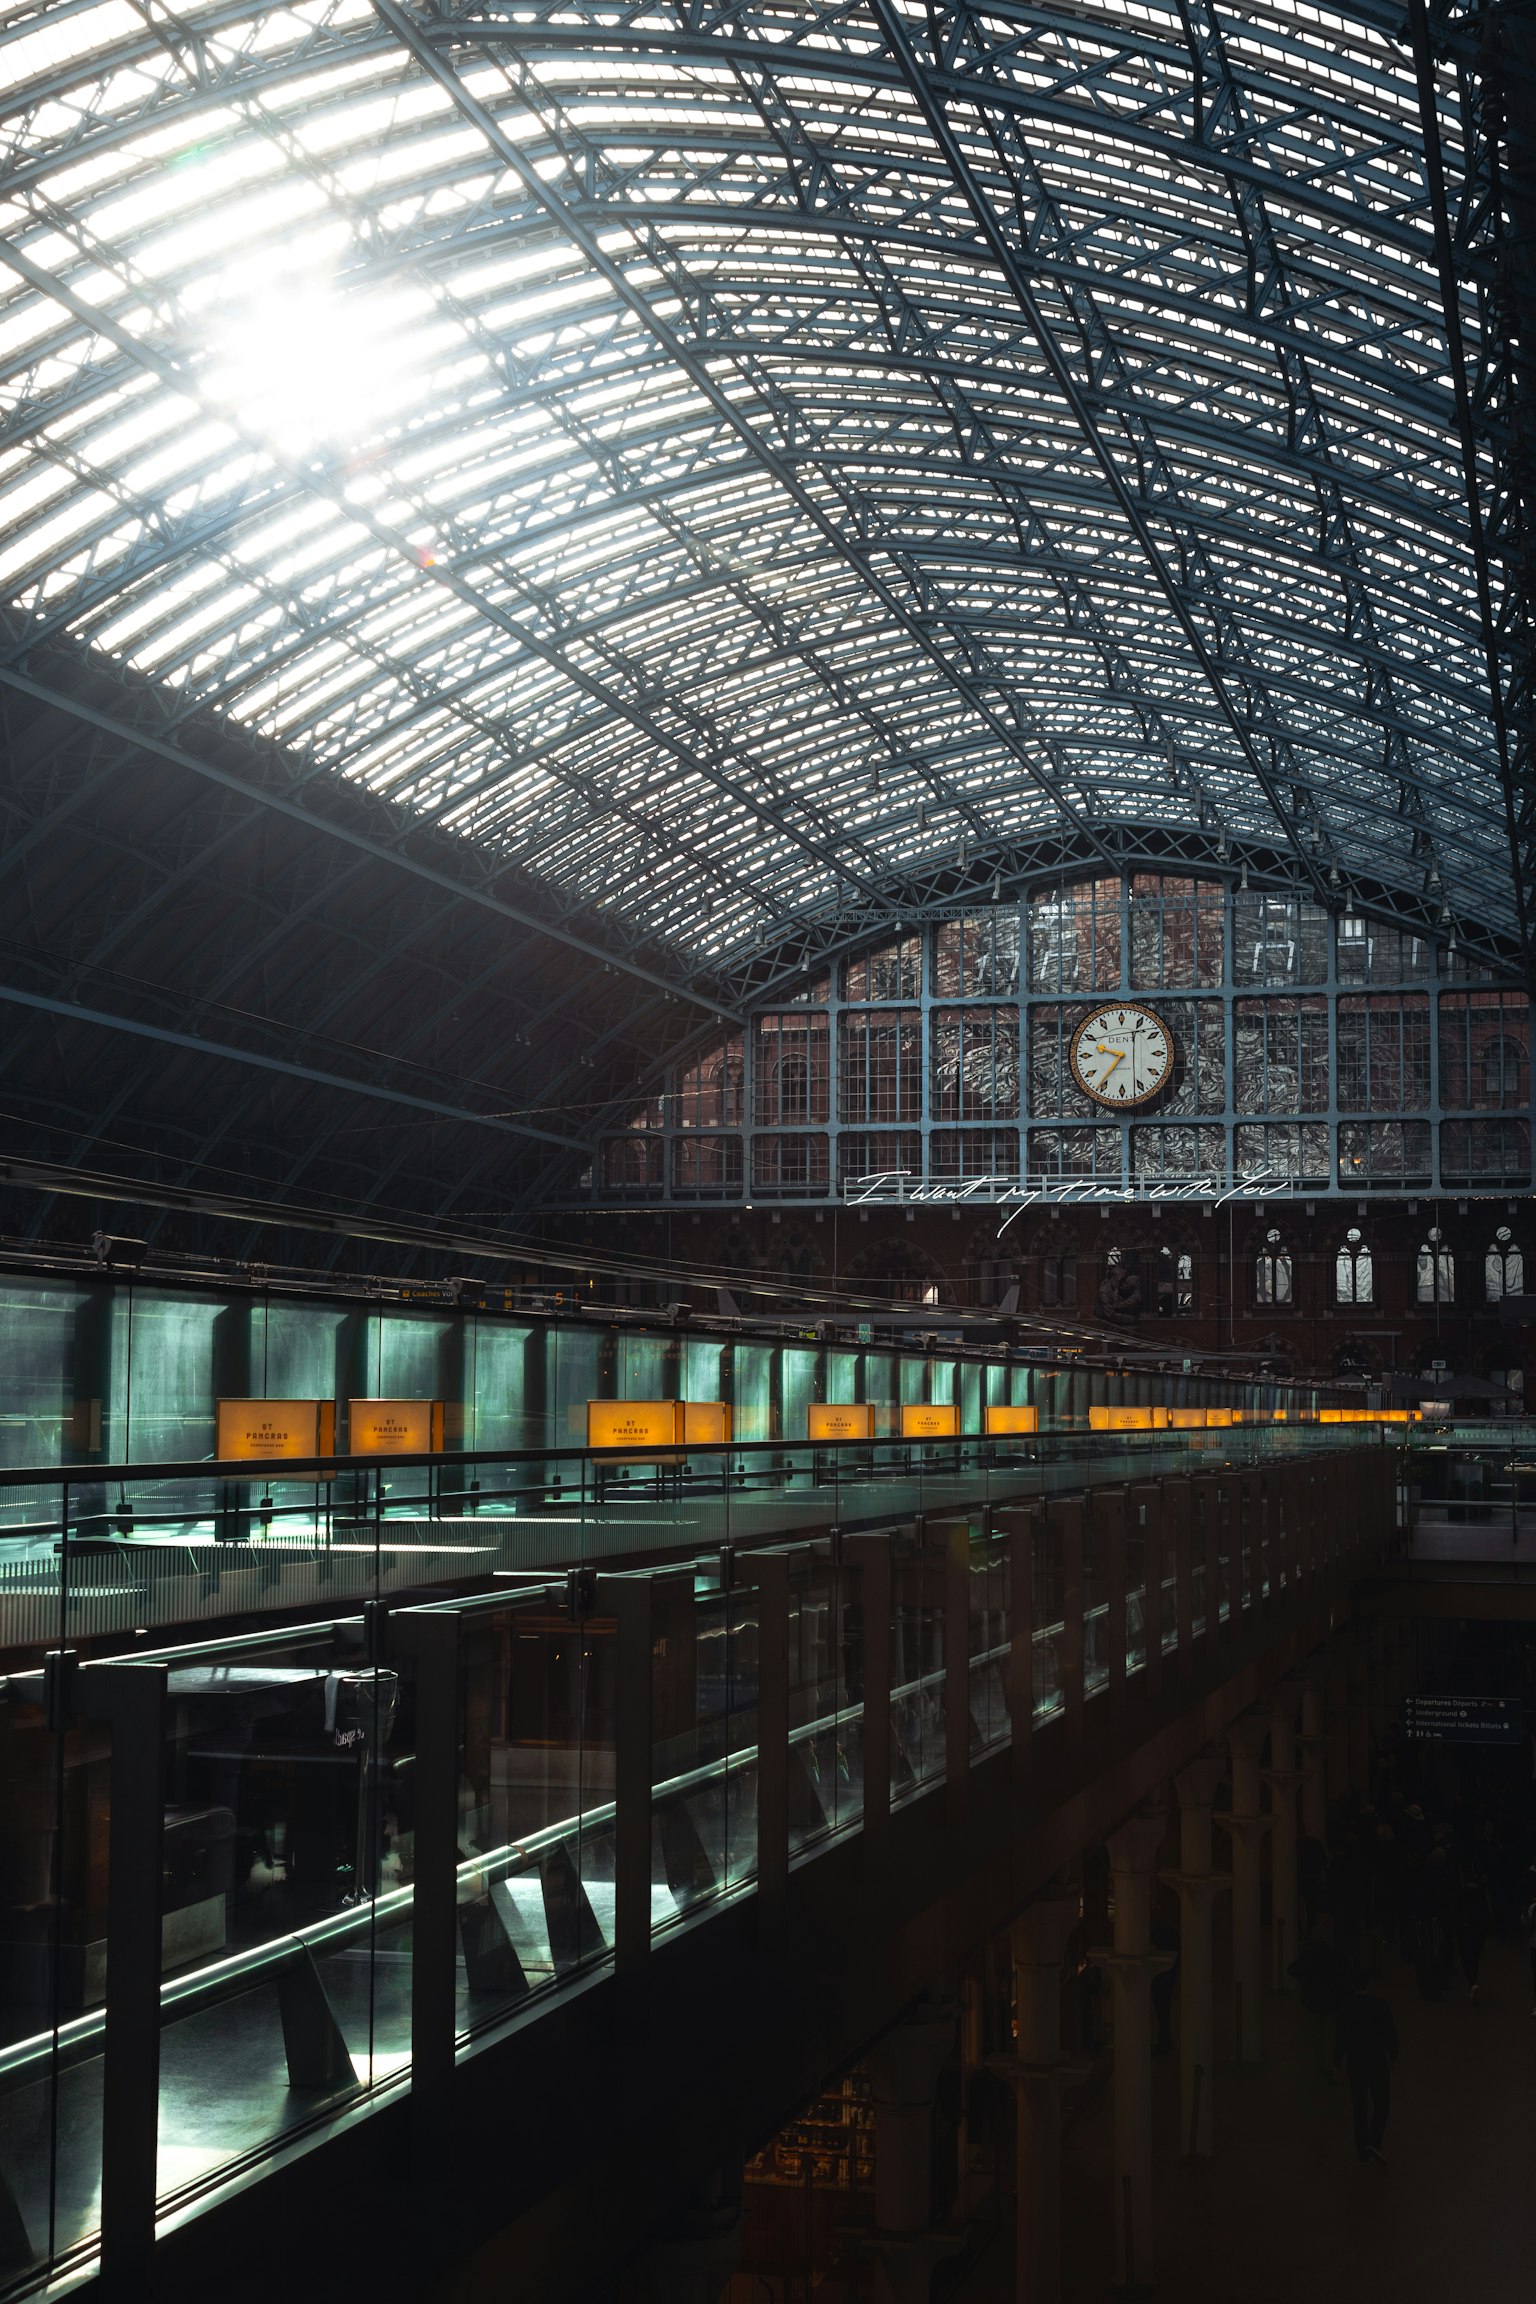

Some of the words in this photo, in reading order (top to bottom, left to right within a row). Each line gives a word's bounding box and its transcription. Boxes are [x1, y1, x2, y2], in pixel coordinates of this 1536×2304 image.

[846, 1170, 912, 1207] I
[554, 1292, 565, 1306] 5
[246, 1432, 288, 1440] PANCRAS
[1415, 1698, 1452, 1707] Departures
[1415, 1709, 1458, 1718] Underground
[1415, 1720, 1457, 1728] International
[1458, 1721, 1479, 1729] tickets
